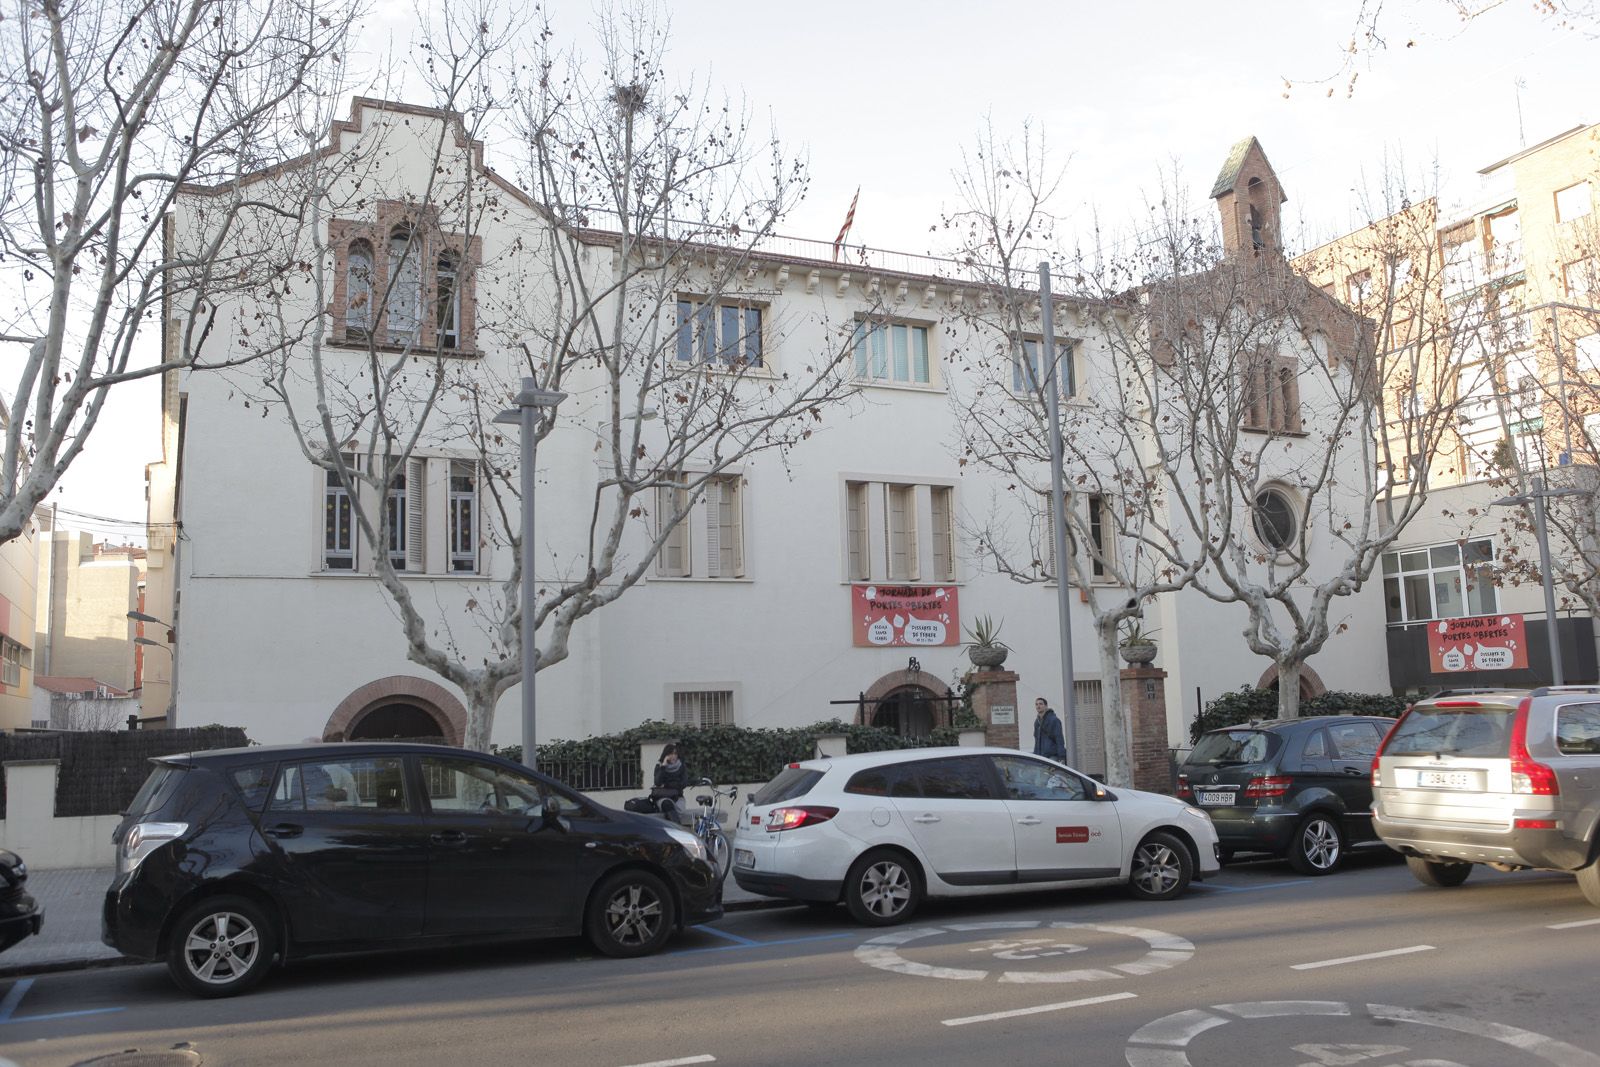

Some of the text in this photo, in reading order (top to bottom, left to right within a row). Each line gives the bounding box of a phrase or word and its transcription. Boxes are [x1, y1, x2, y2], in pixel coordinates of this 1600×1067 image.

[880, 587, 932, 597] JORNADA DE
[870, 600, 942, 611] PORTES OBERTES
[1450, 618, 1497, 630] JORNADA DE
[1442, 629, 1508, 642] PORTES OBERTES
